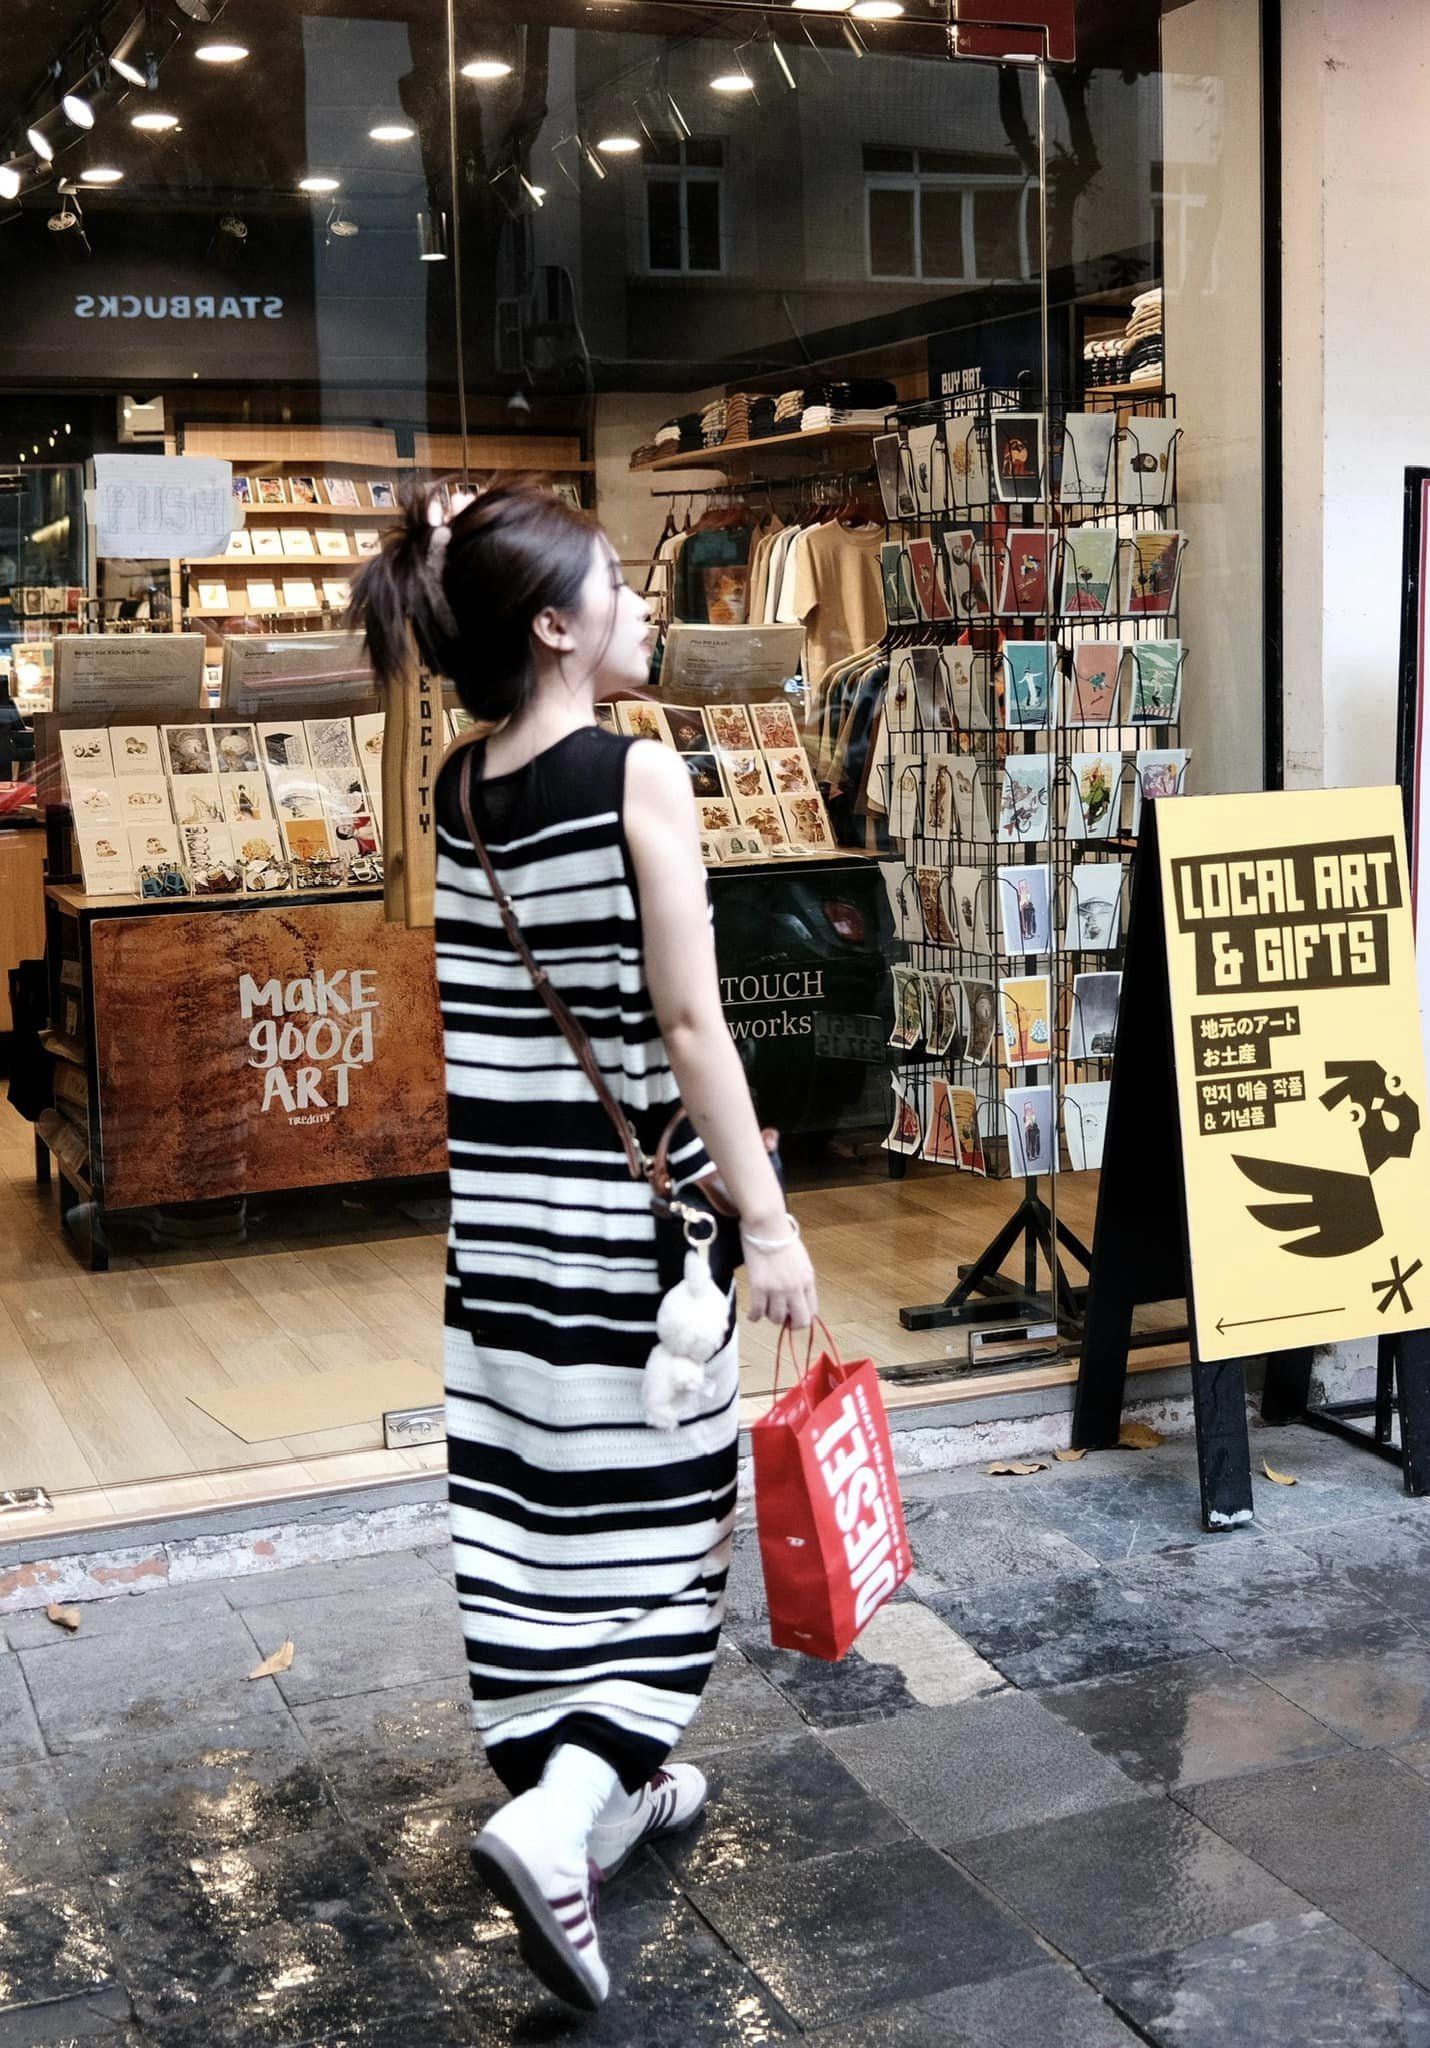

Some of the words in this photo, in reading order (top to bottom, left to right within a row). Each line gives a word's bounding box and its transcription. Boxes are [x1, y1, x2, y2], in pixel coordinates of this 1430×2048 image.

[942, 370, 960, 395] BUY
[102, 485, 225, 537] PUSH
[418, 657, 432, 834] EDCITY
[1180, 858, 1305, 920] LOCAL
[1313, 852, 1392, 910] ART
[1211, 931, 1244, 986] &
[1254, 920, 1377, 983] GIFTS
[720, 970, 825, 1003] TOUCH
[1200, 1012, 1296, 1039] 地元のアート
[1203, 1043, 1256, 1068] お土産
[261, 1063, 363, 1112] ART
[1202, 1083, 1232, 1105] 현지
[1237, 1080, 1268, 1102] 예술
[1273, 1076, 1303, 1098] 작품
[1204, 1112, 1217, 1130] &
[1221, 1106, 1265, 1128] 기념품
[854, 1383, 875, 1441] LIVING
[814, 1393, 898, 1630] DIESEL
